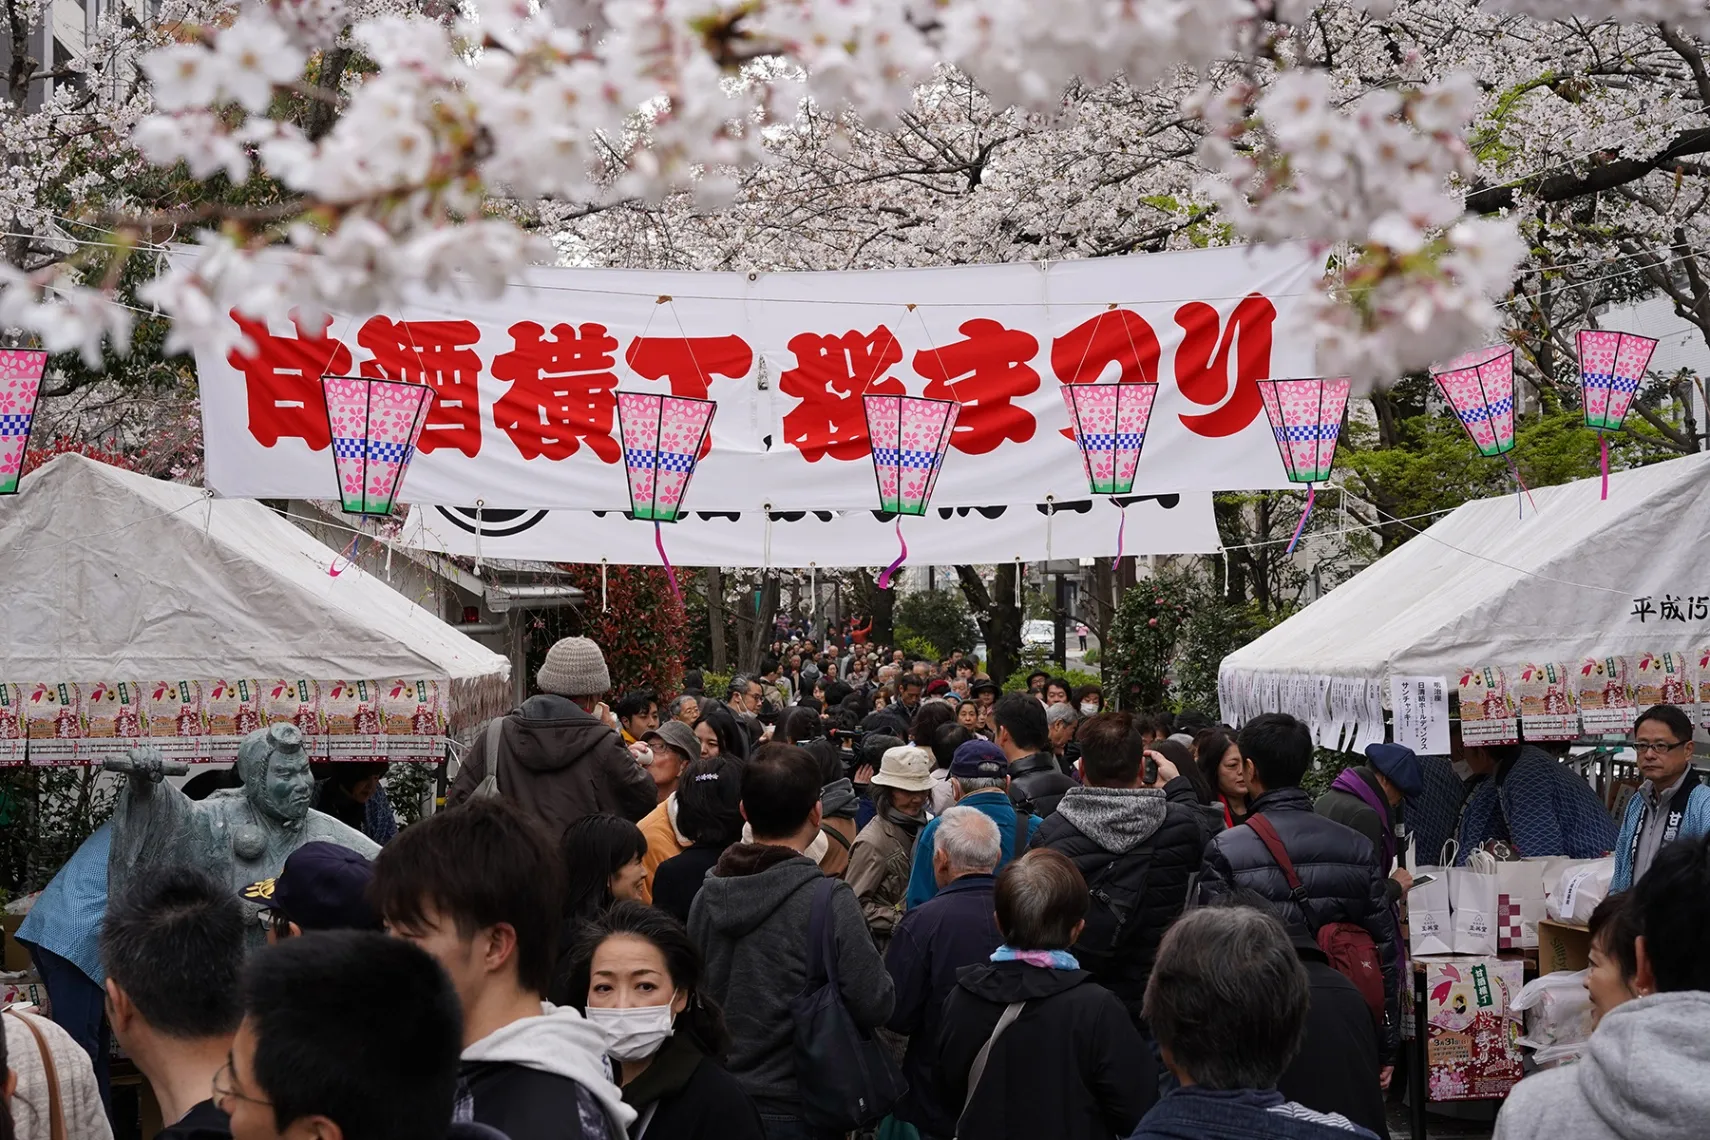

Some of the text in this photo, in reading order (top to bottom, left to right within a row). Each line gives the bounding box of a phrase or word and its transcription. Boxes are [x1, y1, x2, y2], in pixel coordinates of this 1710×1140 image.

[1418, 682, 1428, 750] 日清紡ホールディングス
[1475, 968, 1489, 1004] 甘酒横丁
